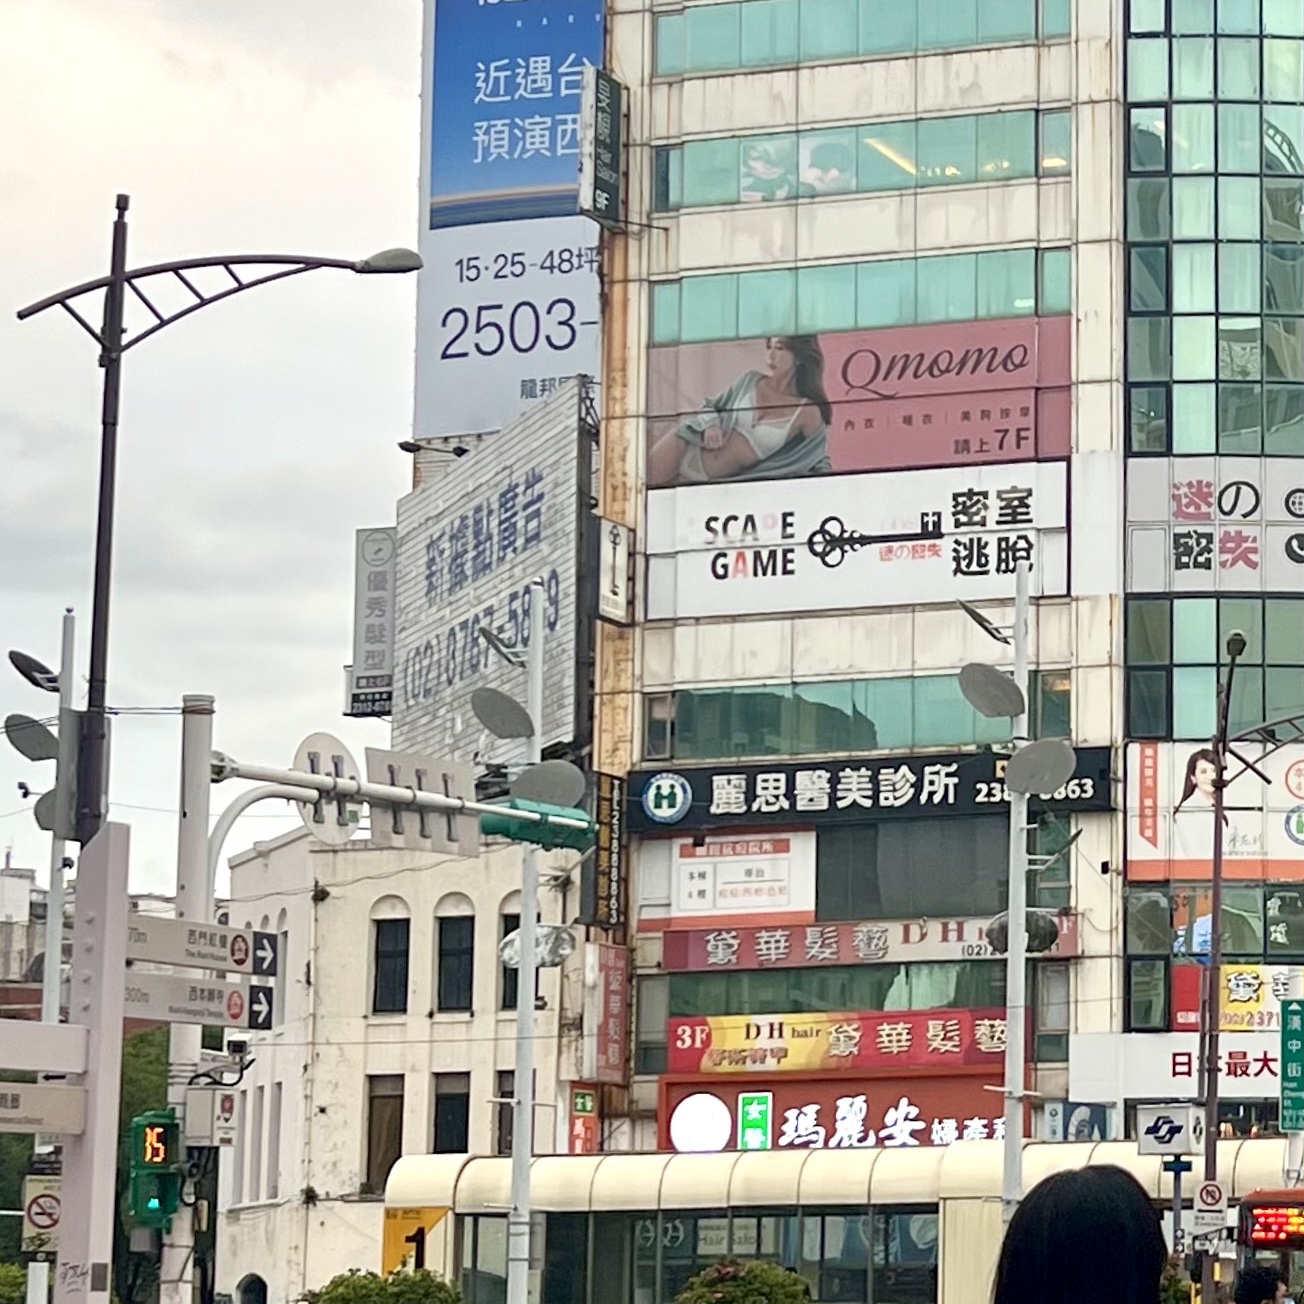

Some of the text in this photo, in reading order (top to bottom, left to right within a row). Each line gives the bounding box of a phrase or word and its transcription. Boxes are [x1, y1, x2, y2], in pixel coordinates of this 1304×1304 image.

[473, 52, 592, 104] 近遇台
[472, 113, 582, 164] 預演西
[841, 344, 1030, 399] Qmomo
[951, 486, 1033, 528] 密室
[1172, 480, 1260, 521] 迷の
[711, 549, 795, 580] GAME
[951, 535, 1034, 577] 逃脫
[709, 763, 959, 815] 麗思醫美診所
[188, 929, 228, 948] 西門紅樓
[704, 925, 891, 965] 黛華髮藝
[676, 1025, 709, 1049] 3F
[791, 1026, 822, 1039] hair
[827, 1019, 1007, 1057] 黛華髮藝
[1286, 1015, 1302, 1077] 漢中街
[778, 1095, 926, 1149] 瑪麗安
[144, 1127, 165, 1163] 15
[405, 1226, 425, 1269] 1
